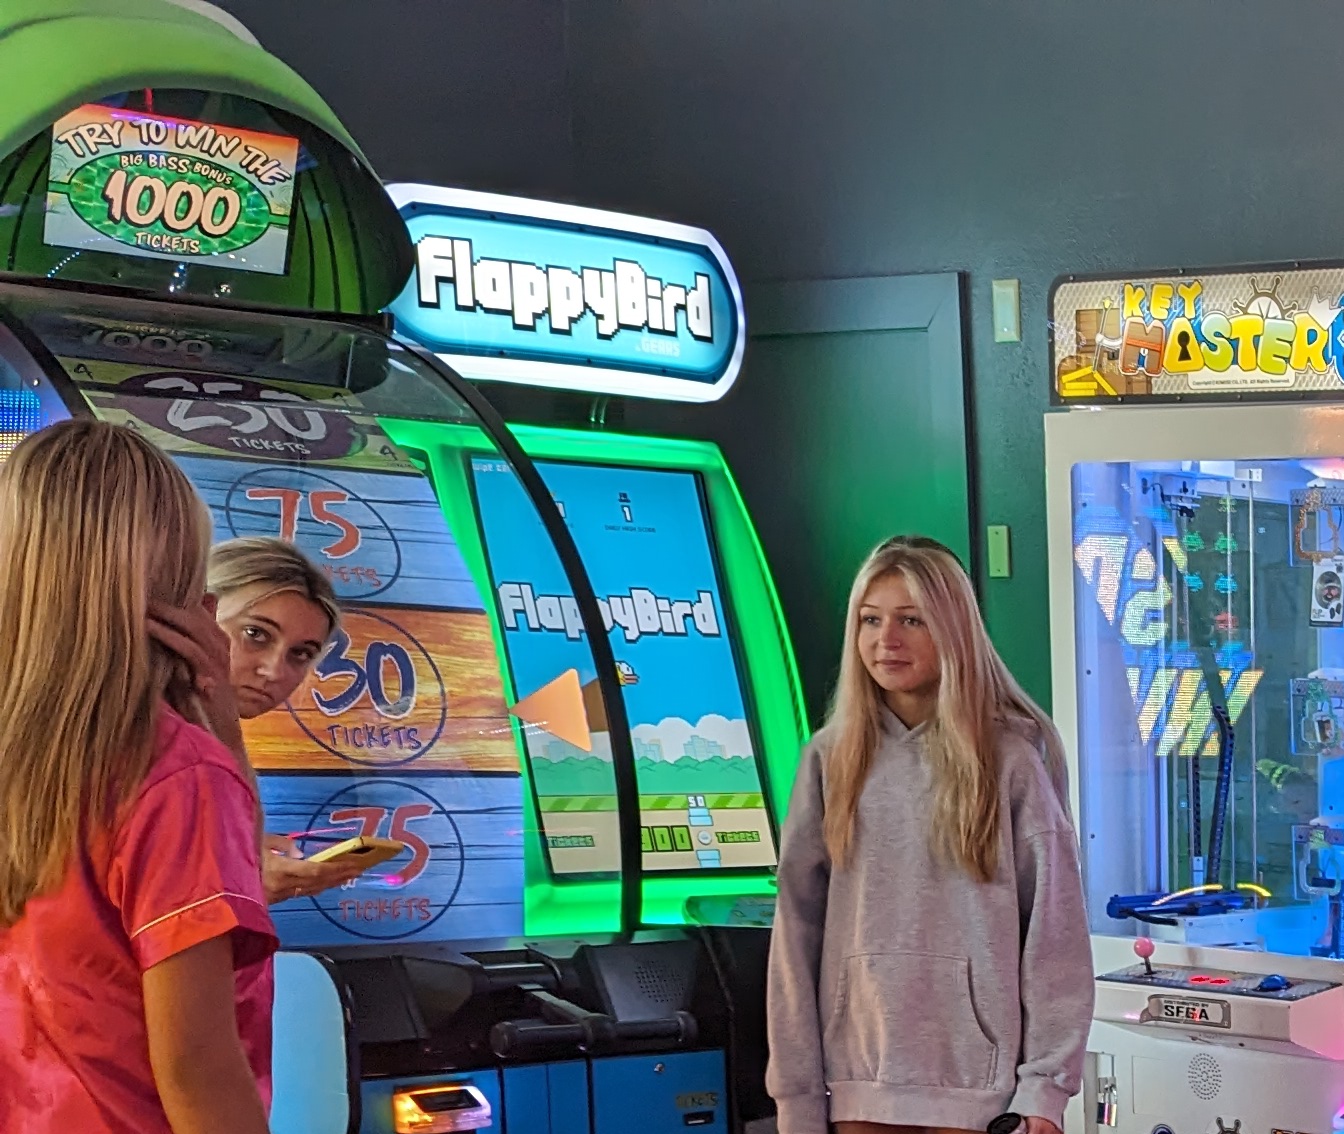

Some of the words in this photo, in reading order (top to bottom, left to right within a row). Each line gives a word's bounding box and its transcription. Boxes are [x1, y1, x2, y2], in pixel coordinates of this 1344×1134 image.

[56, 121, 124, 158] TRY
[131, 119, 168, 145] TO
[176, 124, 240, 158] WIN
[239, 145, 292, 185] THE
[120, 154, 144, 167] BIG
[148, 156, 191, 173] BASS
[193, 163, 233, 185] BONUS
[103, 169, 242, 237] 1000
[135, 232, 200, 254] TICKETS
[416, 234, 714, 343] FlappyBird
[1122, 280, 1203, 320] KEY
[1119, 312, 1330, 376] MASTER
[144, 377, 327, 440] 250
[228, 436, 311, 455] TICKETS
[245, 488, 361, 559] 75
[312, 627, 417, 719] 30
[327, 724, 422, 750] TICKETS
[687, 795, 705, 808] 50
[329, 804, 434, 890] 75
[339, 897, 432, 921] TICKETS
